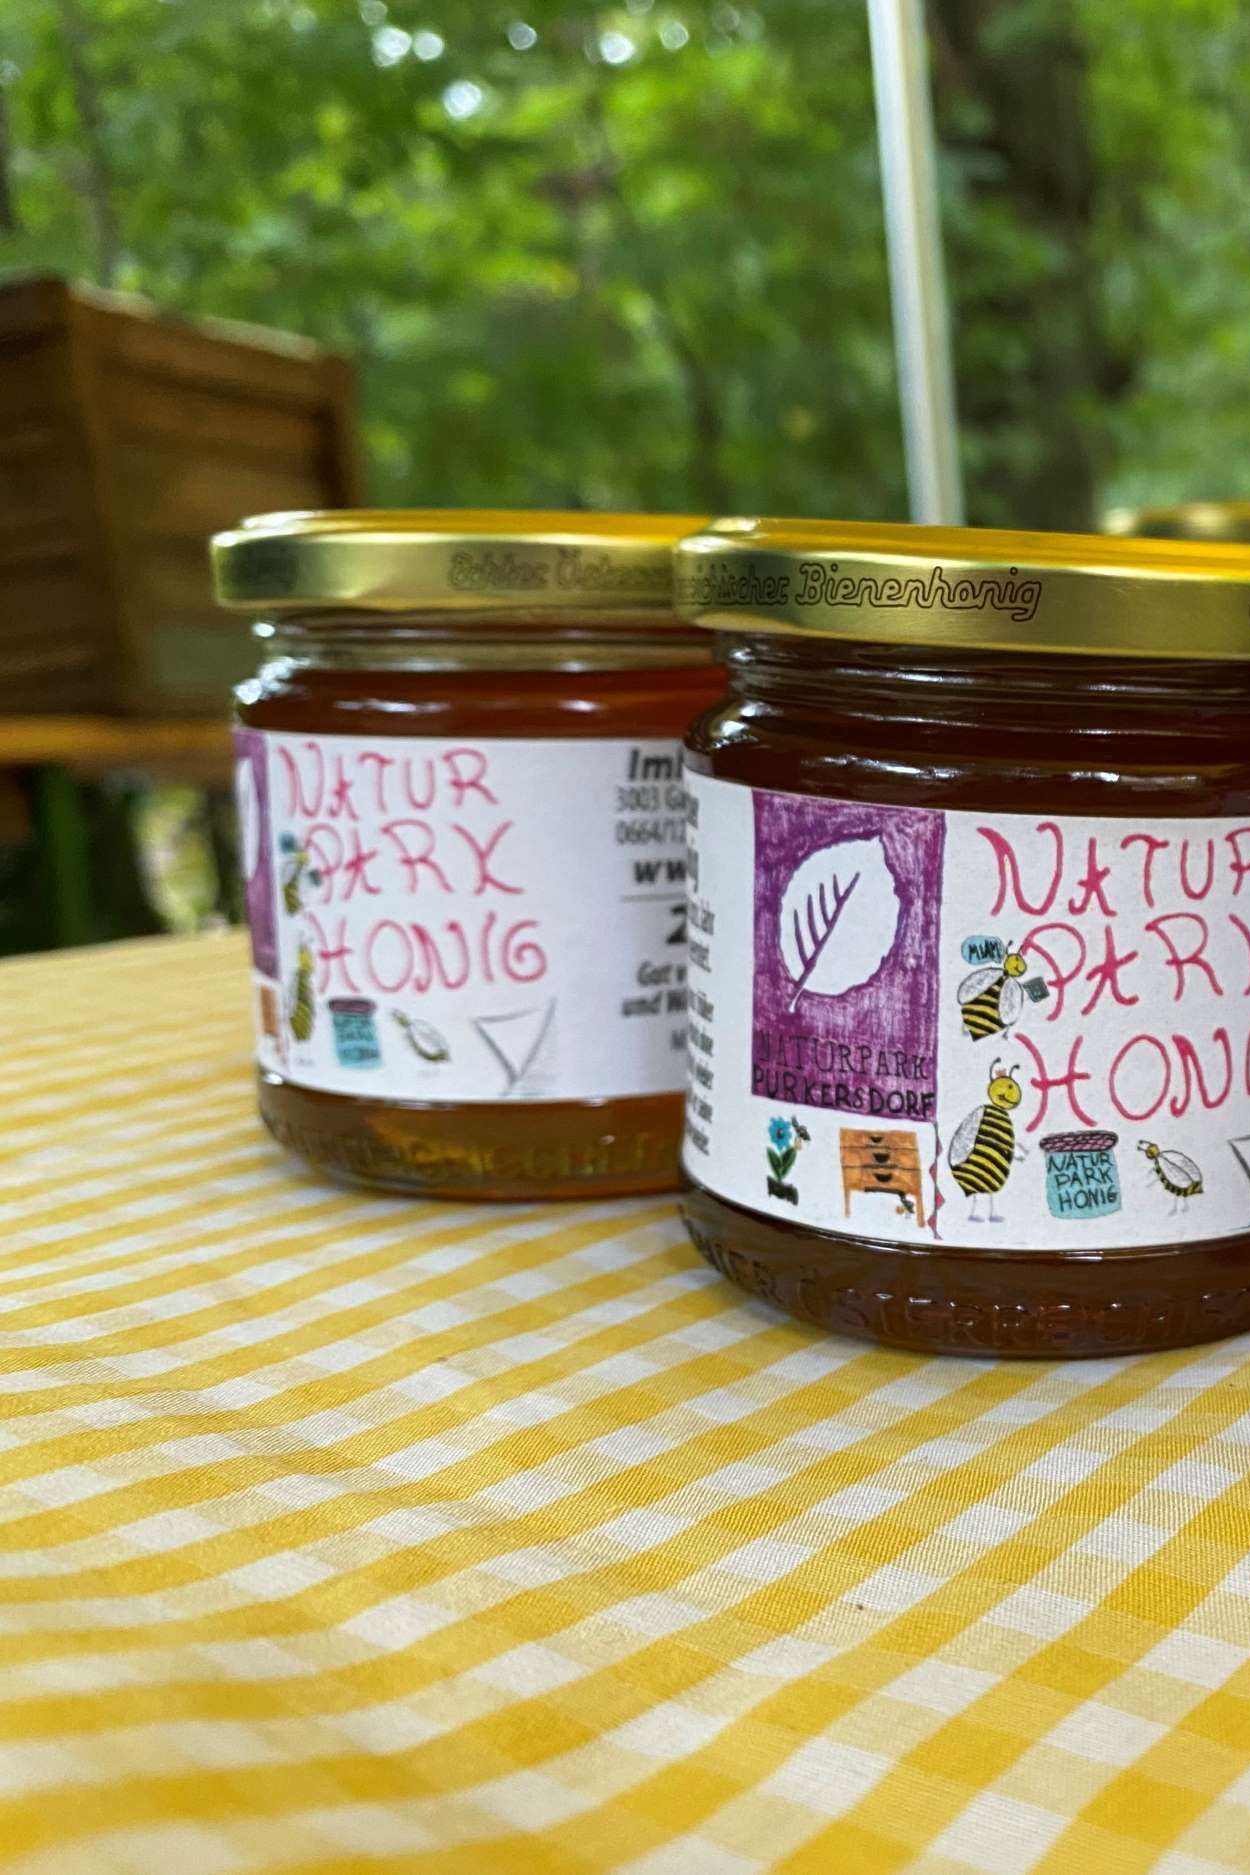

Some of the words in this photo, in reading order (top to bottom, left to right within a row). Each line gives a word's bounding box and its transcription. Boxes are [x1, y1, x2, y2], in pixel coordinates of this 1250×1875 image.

[795, 562, 1042, 623] Bienenhonig
[277, 741, 499, 821] NATUR
[303, 821, 524, 905] PARK
[303, 909, 547, 995] HONIG
[754, 1029, 929, 1081] NATURPARK
[752, 1063, 935, 1118] PURKERSDORF
[1048, 1152, 1114, 1174] NATUR
[1055, 1166, 1113, 1190] PARK
[1058, 1184, 1118, 1212] HONIG
